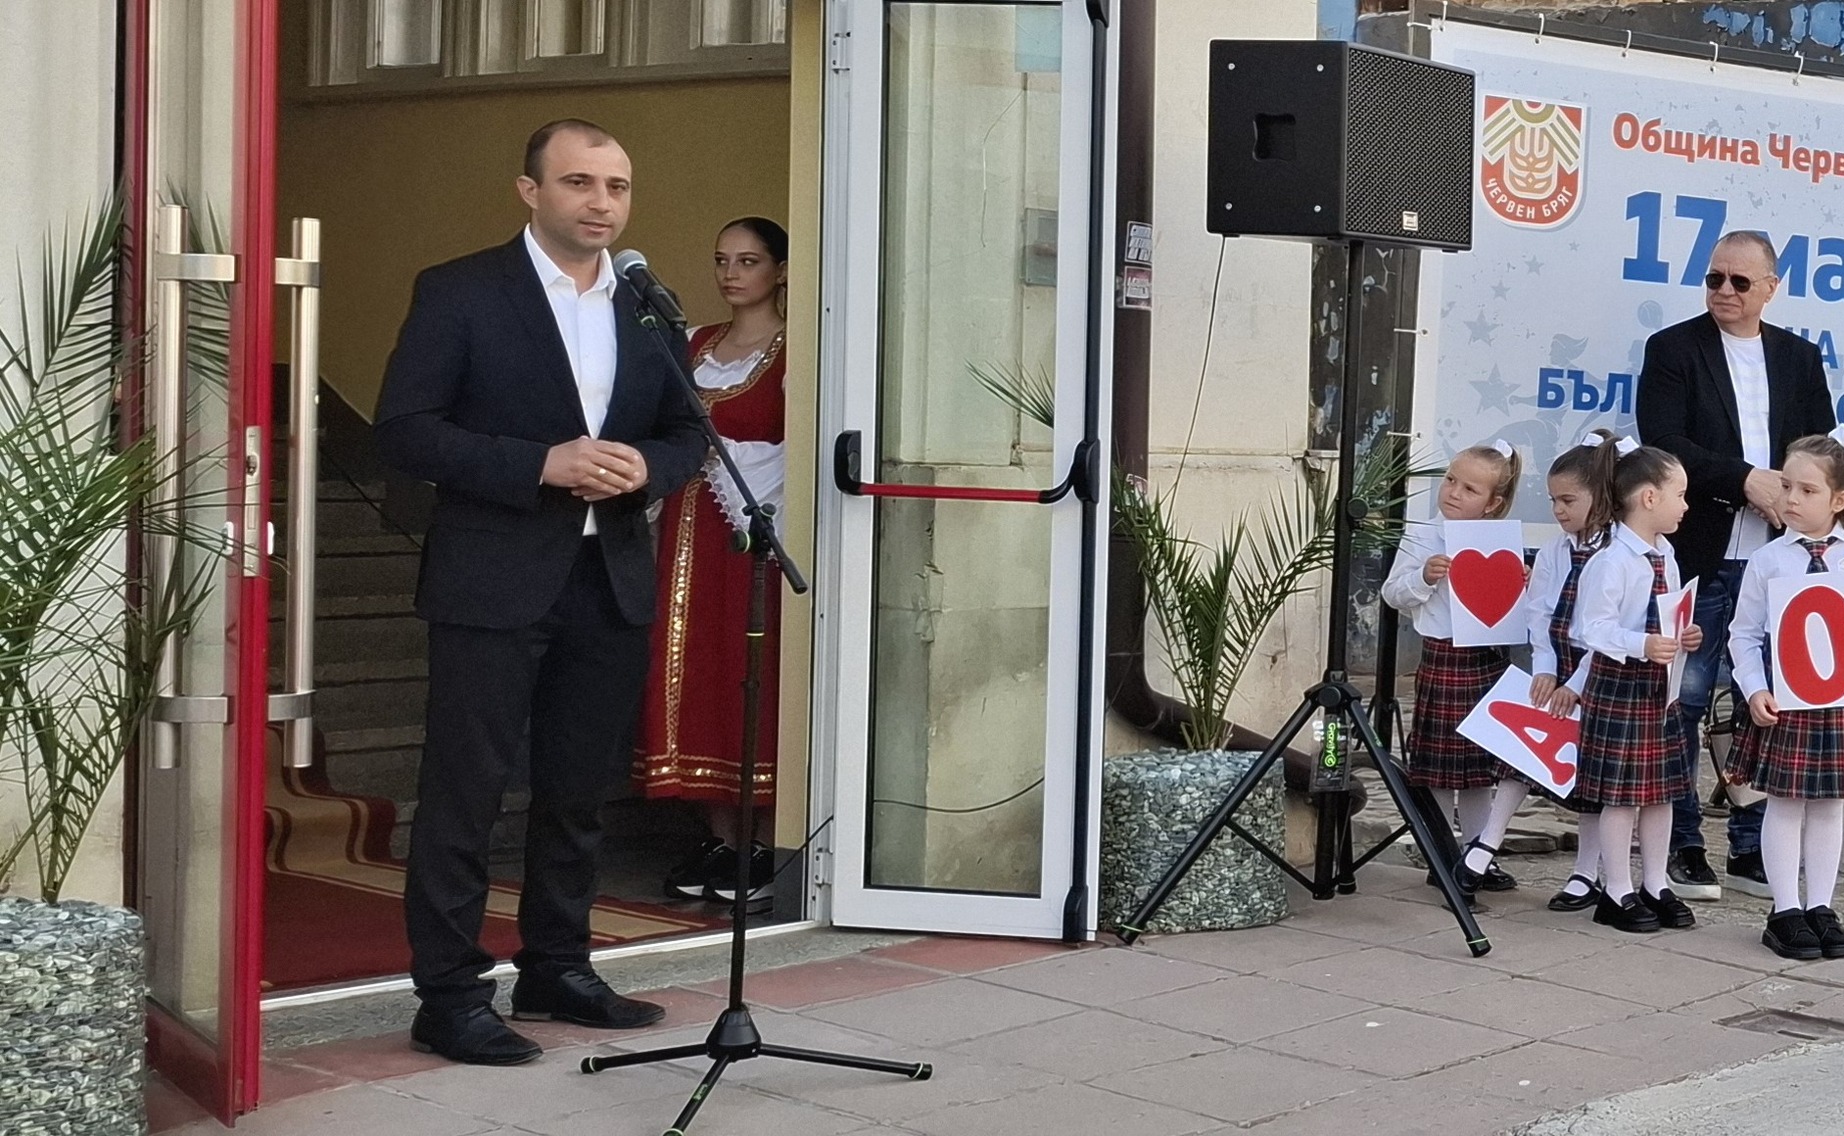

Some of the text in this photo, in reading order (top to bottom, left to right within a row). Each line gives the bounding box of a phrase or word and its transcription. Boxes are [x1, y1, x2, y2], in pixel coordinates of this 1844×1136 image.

[1612, 112, 1760, 166] Община
[1486, 178, 1573, 219] ЧЕРВЕН БРЯГ
[1622, 191, 1728, 287] 17
